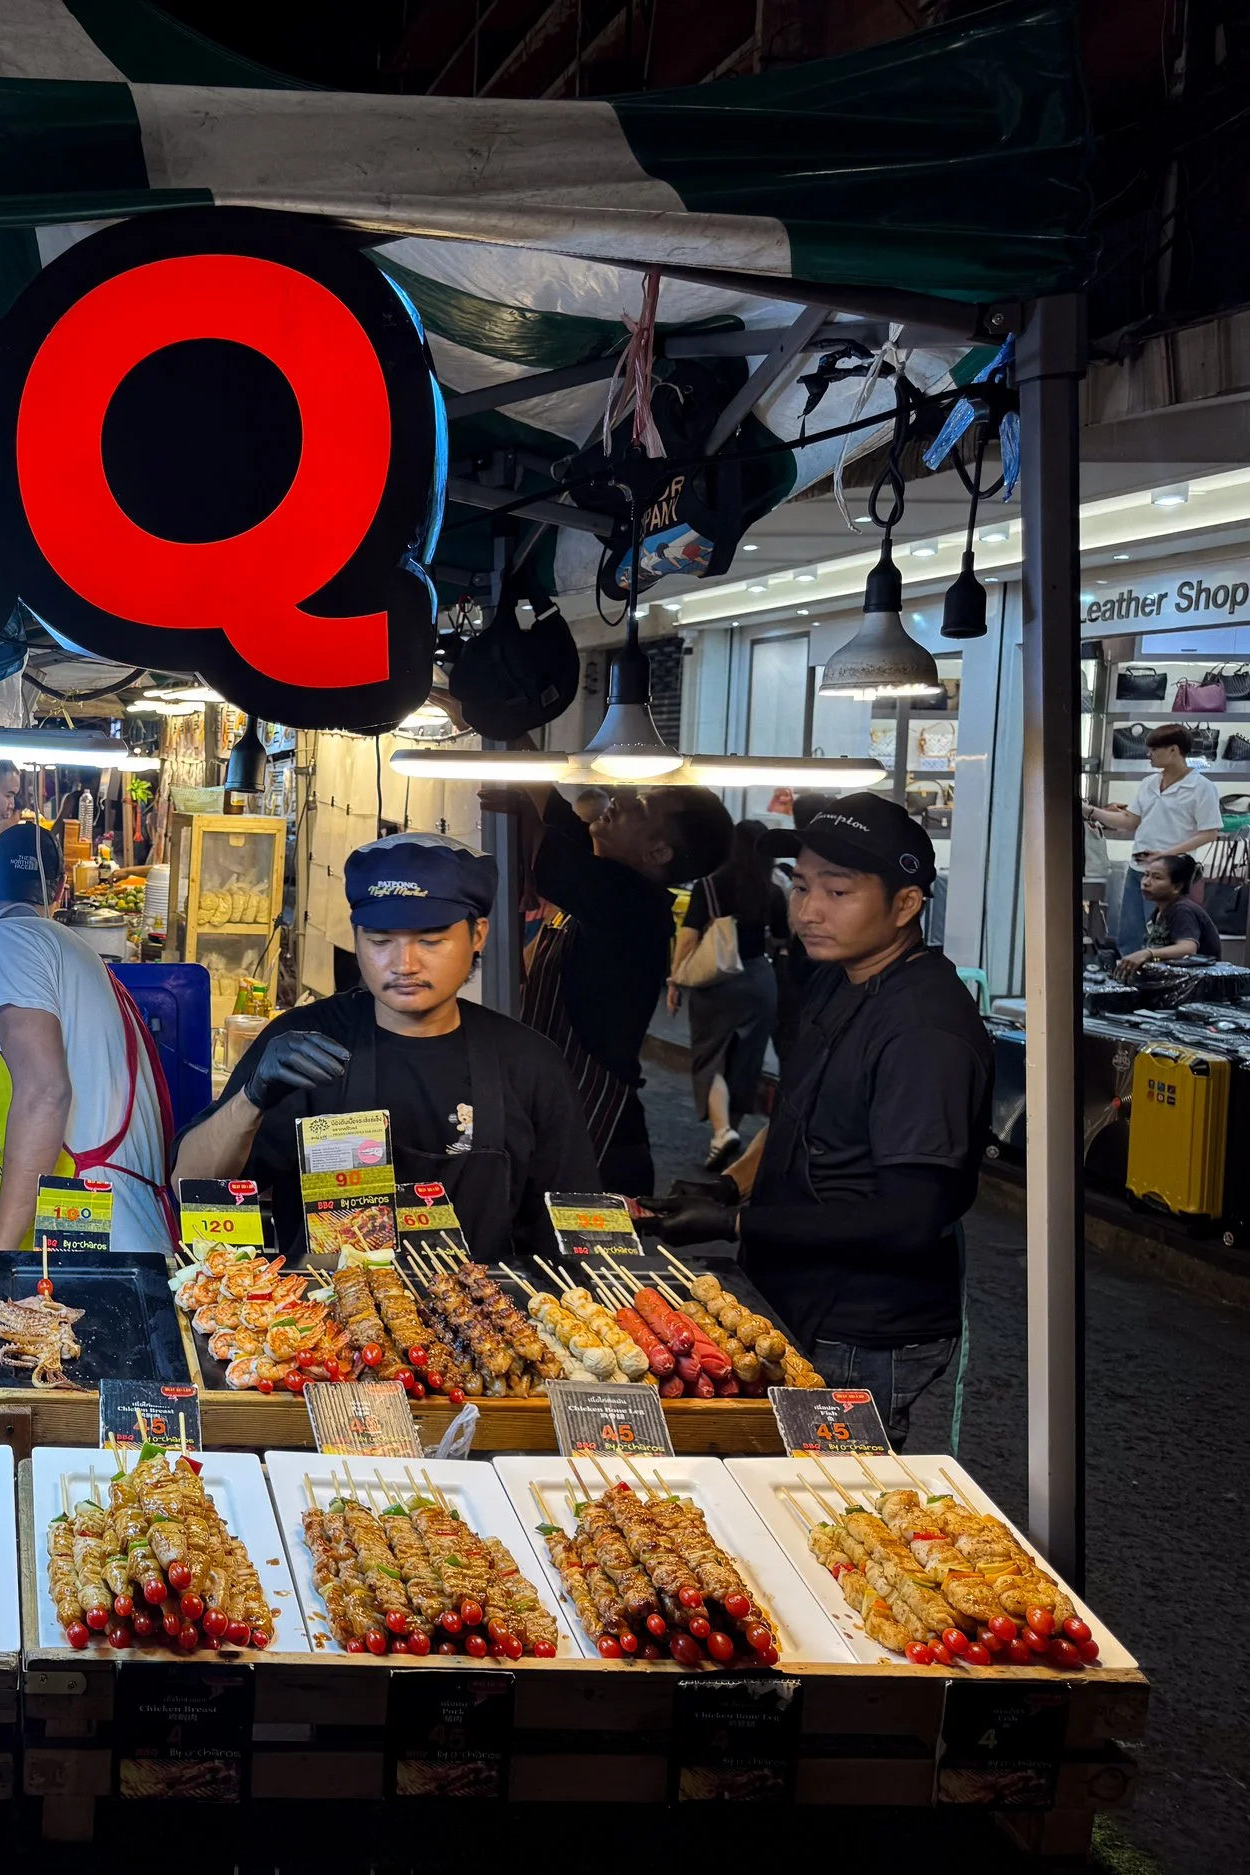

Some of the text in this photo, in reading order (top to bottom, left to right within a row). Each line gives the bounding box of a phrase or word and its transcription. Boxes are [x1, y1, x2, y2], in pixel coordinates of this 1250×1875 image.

[1080, 580, 1250, 624] eather Shop
[377, 880, 418, 890] PATPONG
[335, 1170, 361, 1187] 90
[317, 1201, 334, 1210] BBQ
[340, 1199, 350, 1208] By
[54, 1207, 92, 1221] 100
[403, 1213, 430, 1227] 60
[201, 1219, 234, 1233] 120
[63, 1239, 71, 1249] By
[573, 1246, 589, 1254] BBQ
[567, 1405, 603, 1413] Chicken
[629, 1407, 645, 1415] Leg
[133, 1418, 167, 1434] 45
[816, 1422, 850, 1440] 45
[602, 1424, 635, 1442] 45
[605, 1443, 615, 1451] By
[802, 1442, 821, 1450] BBQ
[828, 1443, 839, 1451] By
[139, 1704, 217, 1713] Chicken Breast
[694, 1711, 733, 1719] Chicken
[428, 1721, 466, 1749] 45
[978, 1728, 998, 1749] 4
[170, 1747, 182, 1758] By
